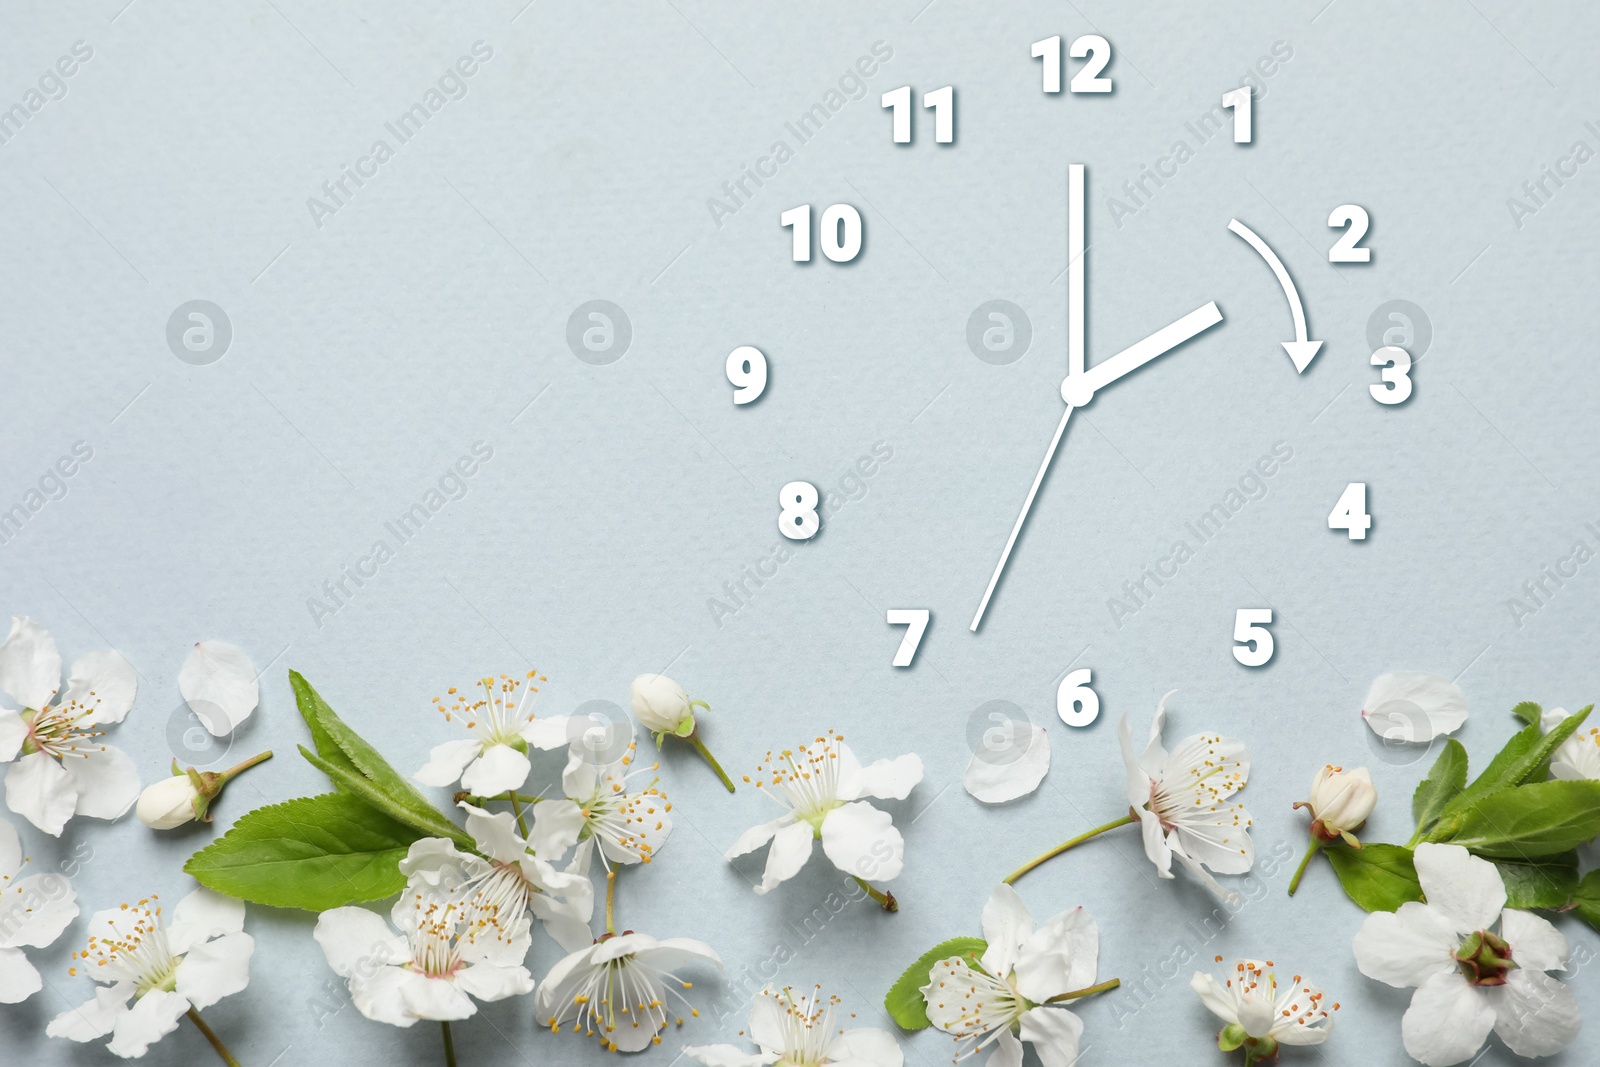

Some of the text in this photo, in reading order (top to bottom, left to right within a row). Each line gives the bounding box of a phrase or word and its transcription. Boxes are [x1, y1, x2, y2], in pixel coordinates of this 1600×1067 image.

[1032, 35, 1112, 93] 12
[882, 85, 953, 143] 11
[1222, 85, 1251, 143] 1
[781, 204, 862, 262] 10
[1328, 205, 1370, 262] 2
[725, 346, 767, 405] 9
[1369, 346, 1412, 405] 3
[778, 481, 820, 540] 8
[1328, 483, 1371, 540] 4
[886, 609, 929, 667] 7
[1232, 609, 1274, 667] 5
[1056, 669, 1099, 727] 6
